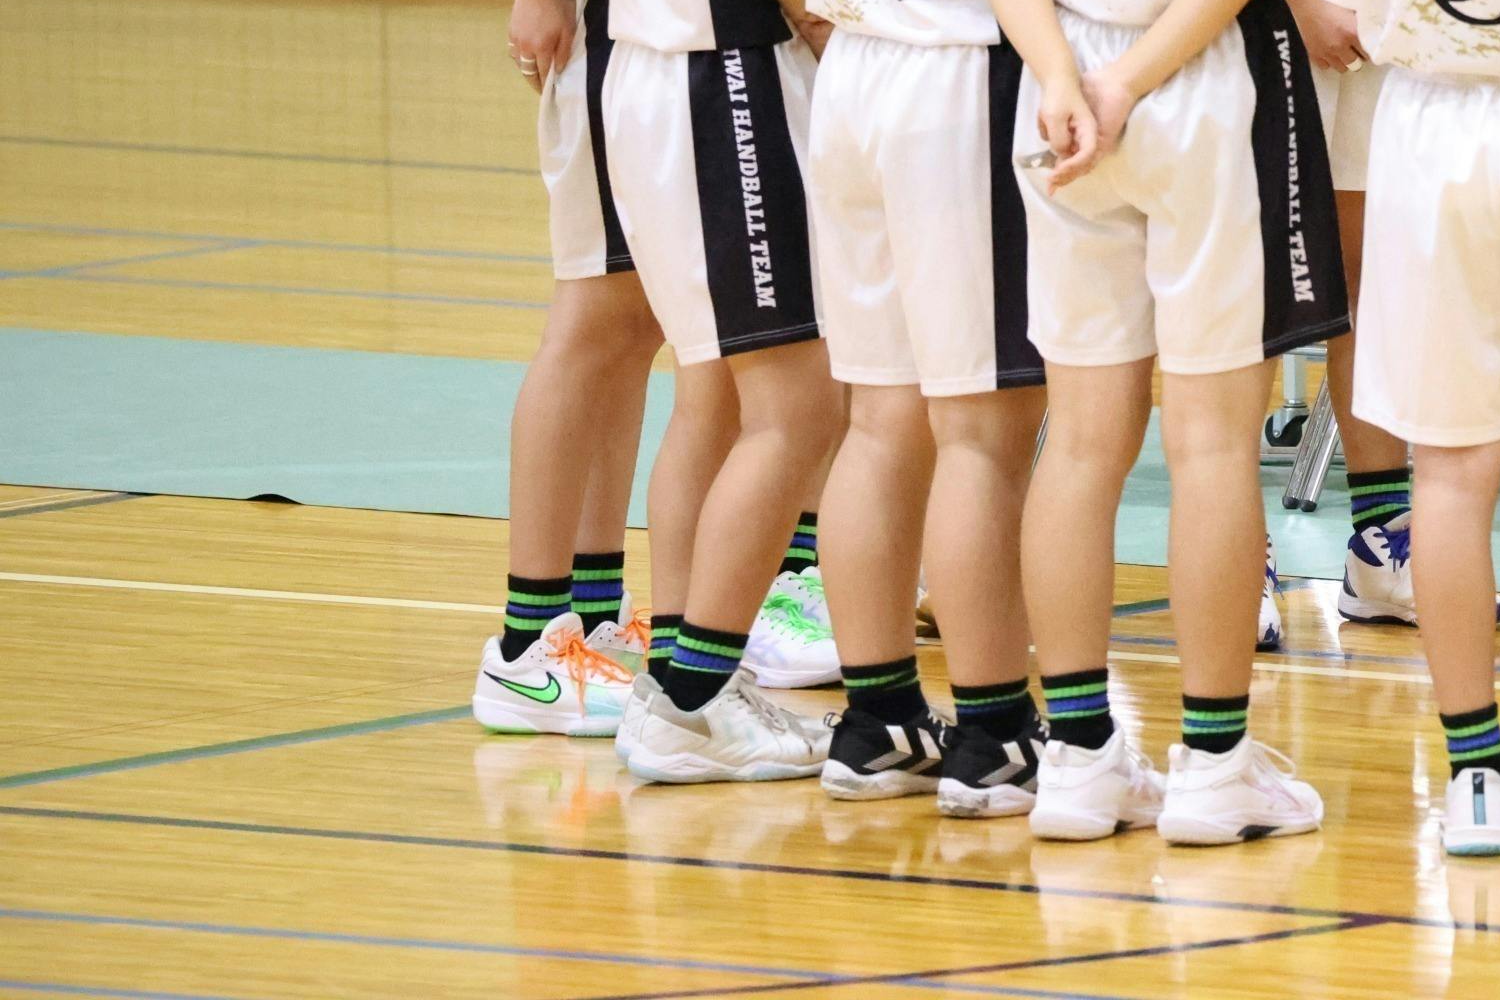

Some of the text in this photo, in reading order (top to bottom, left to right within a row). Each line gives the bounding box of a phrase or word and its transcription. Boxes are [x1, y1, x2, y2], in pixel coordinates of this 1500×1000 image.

[723, 48, 777, 308] IWAI HANDBALL TEAM
[1288, 230, 1315, 302] TEAM
